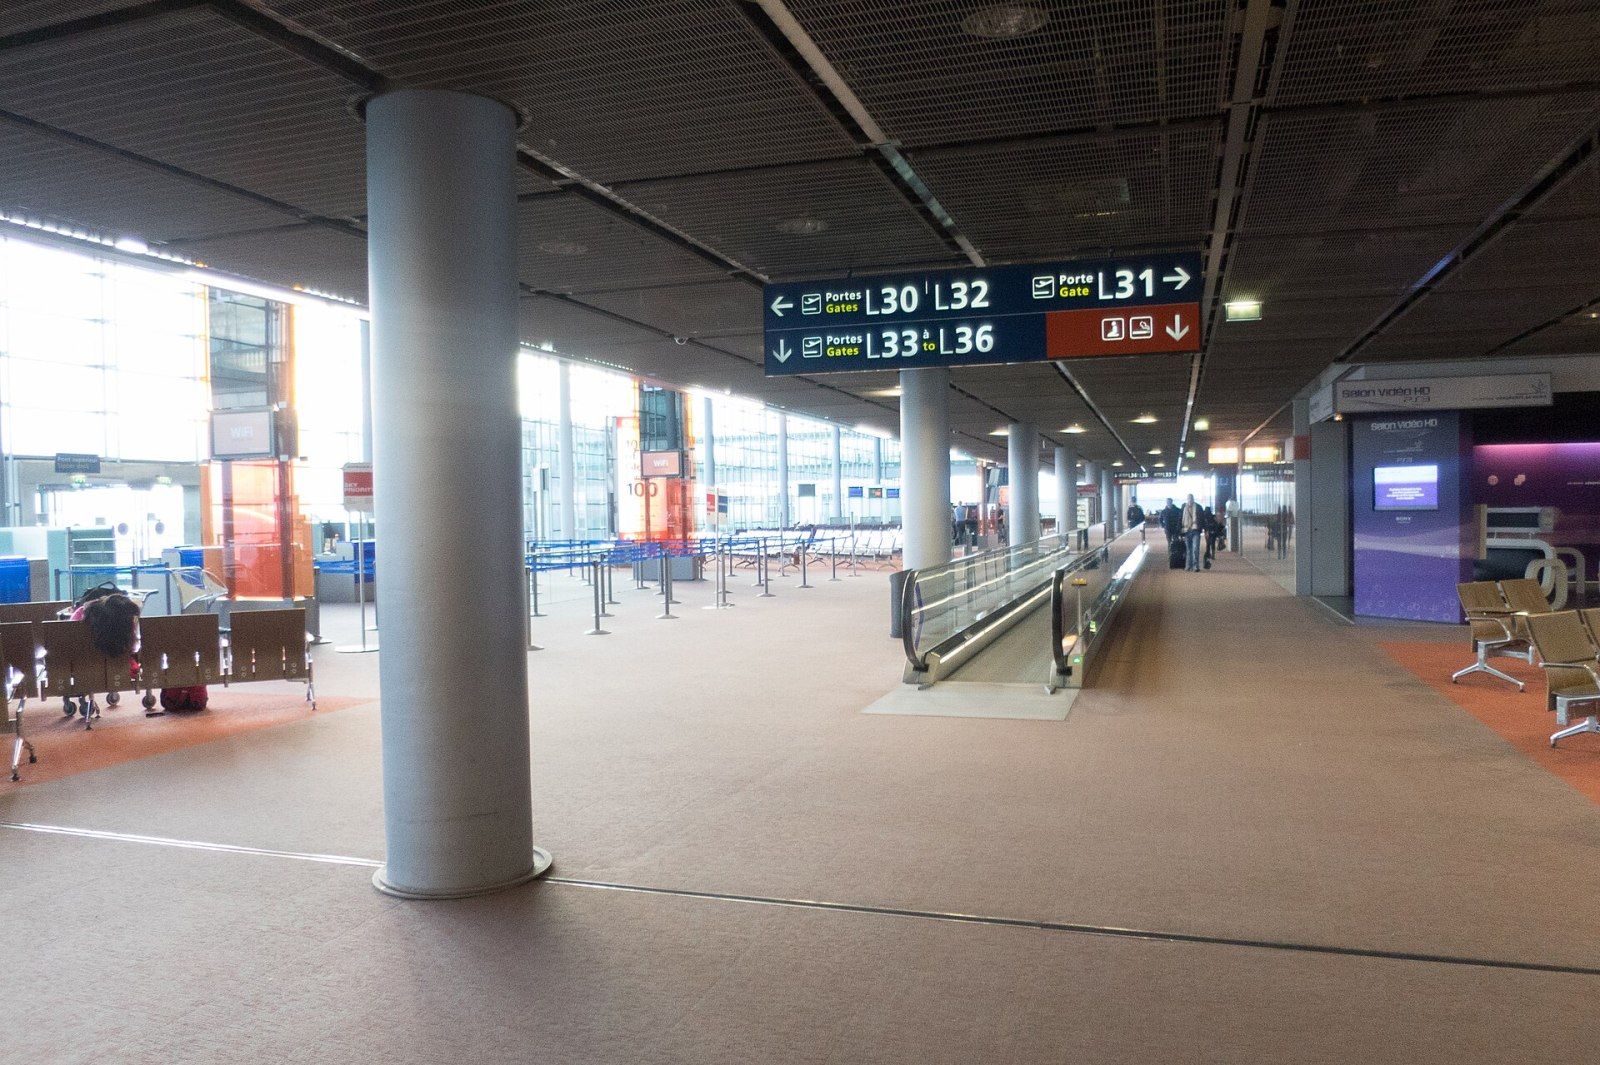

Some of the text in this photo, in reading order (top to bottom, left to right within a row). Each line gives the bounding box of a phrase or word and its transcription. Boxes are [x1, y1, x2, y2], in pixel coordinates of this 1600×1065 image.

[1059, 273, 1094, 285] Porte
[1098, 268, 1153, 300] L31
[825, 290, 862, 302] Portes
[866, 280, 989, 316] L30 L32
[1059, 286, 1090, 298] Gate
[825, 302, 859, 314] Gates
[826, 334, 863, 346] Portes
[867, 325, 995, 359] L33 à L36
[826, 341, 936, 357] Gates to
[1342, 387, 1376, 399] Salon
[1371, 420, 1397, 431] Salon
[1424, 418, 1438, 427] HD
